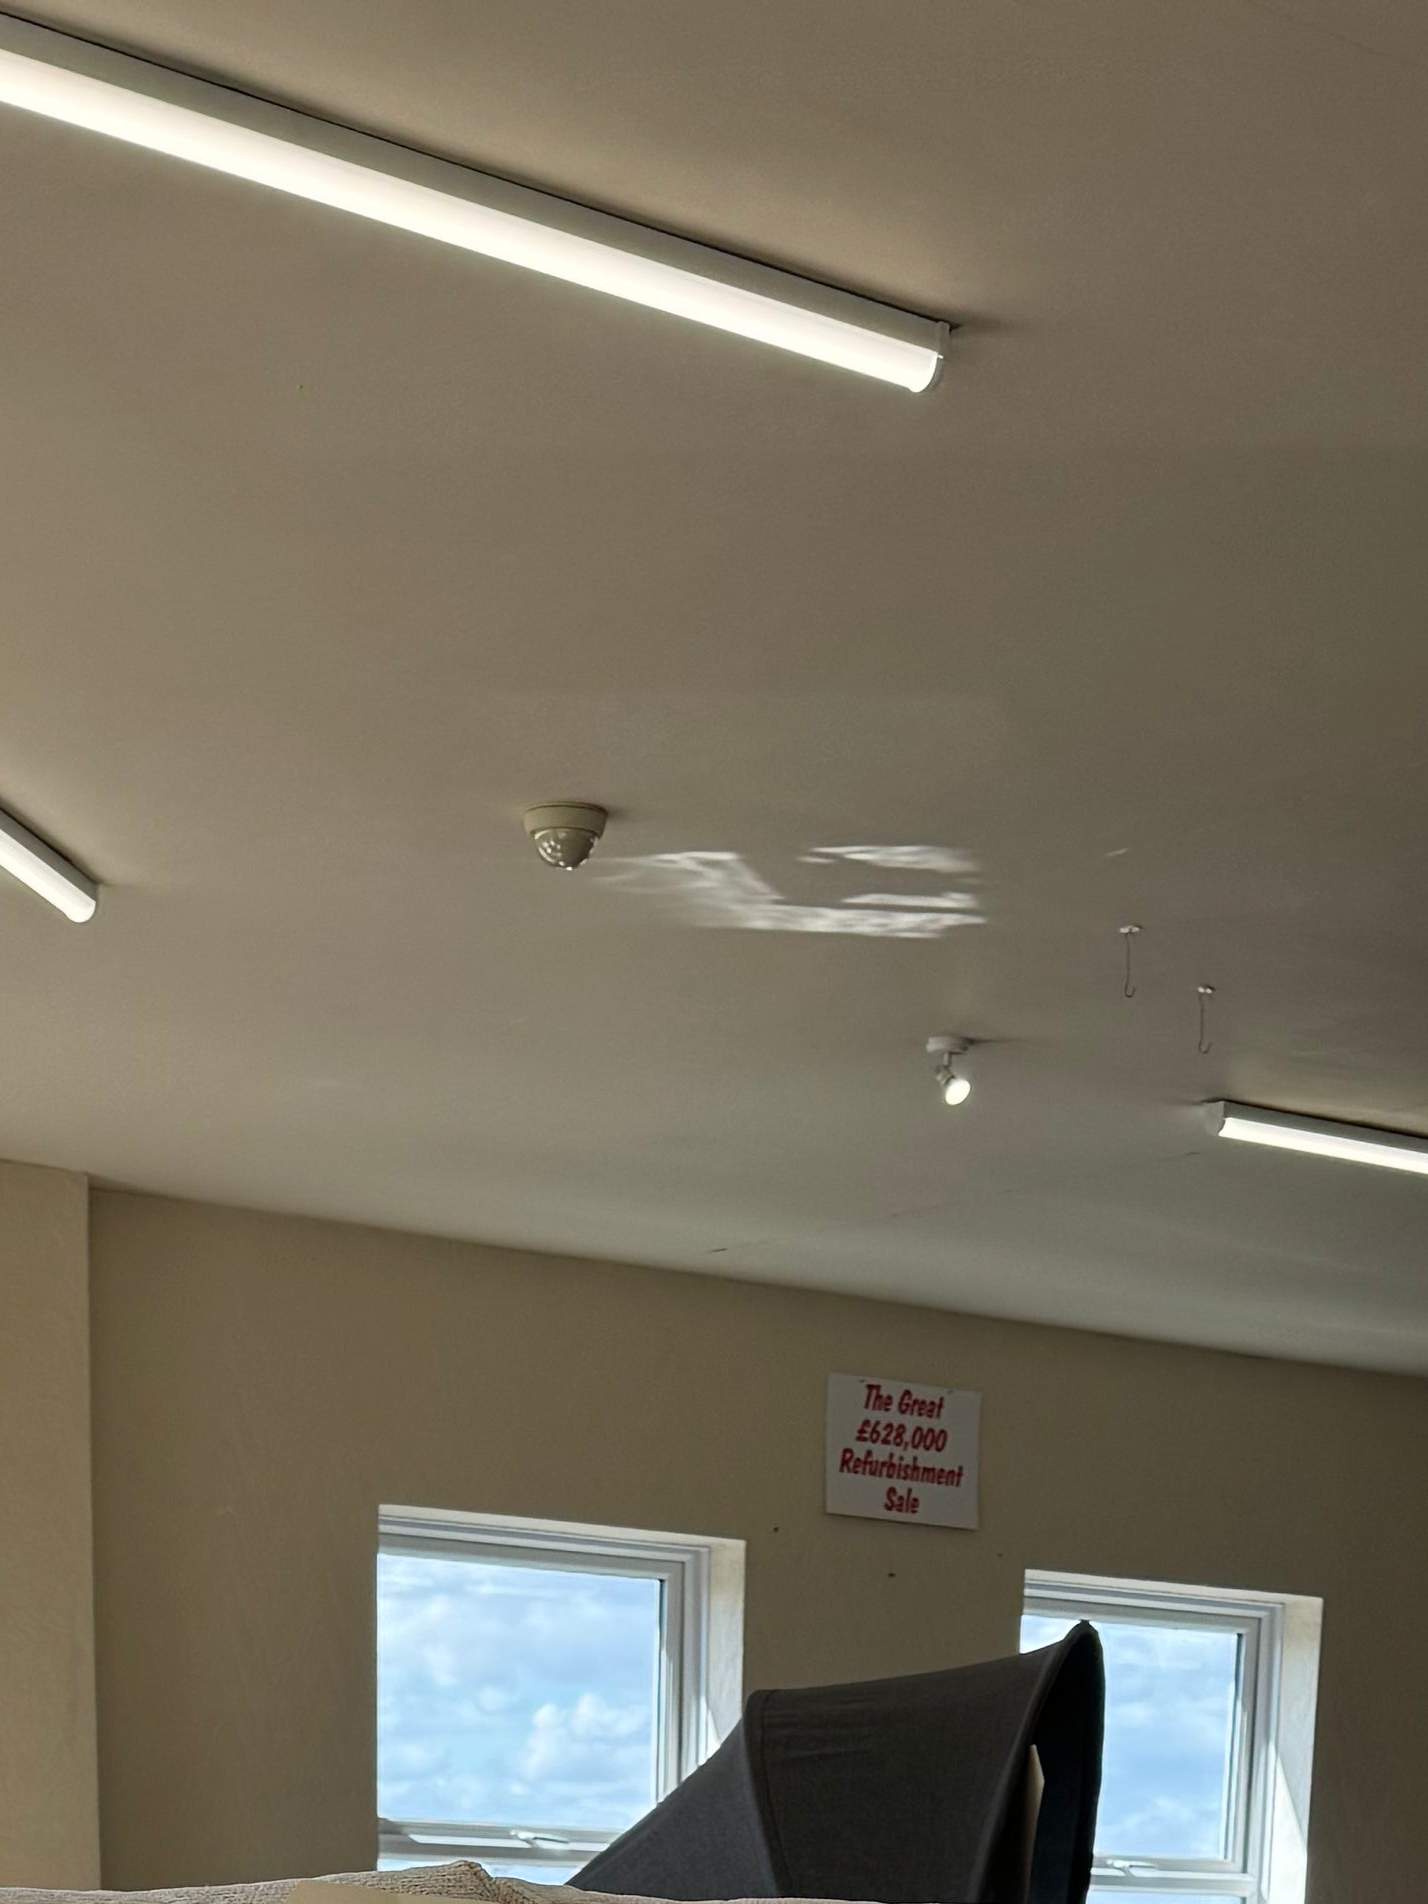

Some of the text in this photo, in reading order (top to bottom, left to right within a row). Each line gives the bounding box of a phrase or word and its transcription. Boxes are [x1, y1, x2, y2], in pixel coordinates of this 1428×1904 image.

[864, 1384, 945, 1419] The Great
[855, 1419, 948, 1453] £628,000
[839, 1448, 964, 1487] Refurbishment
[884, 1486, 920, 1514] Sale
